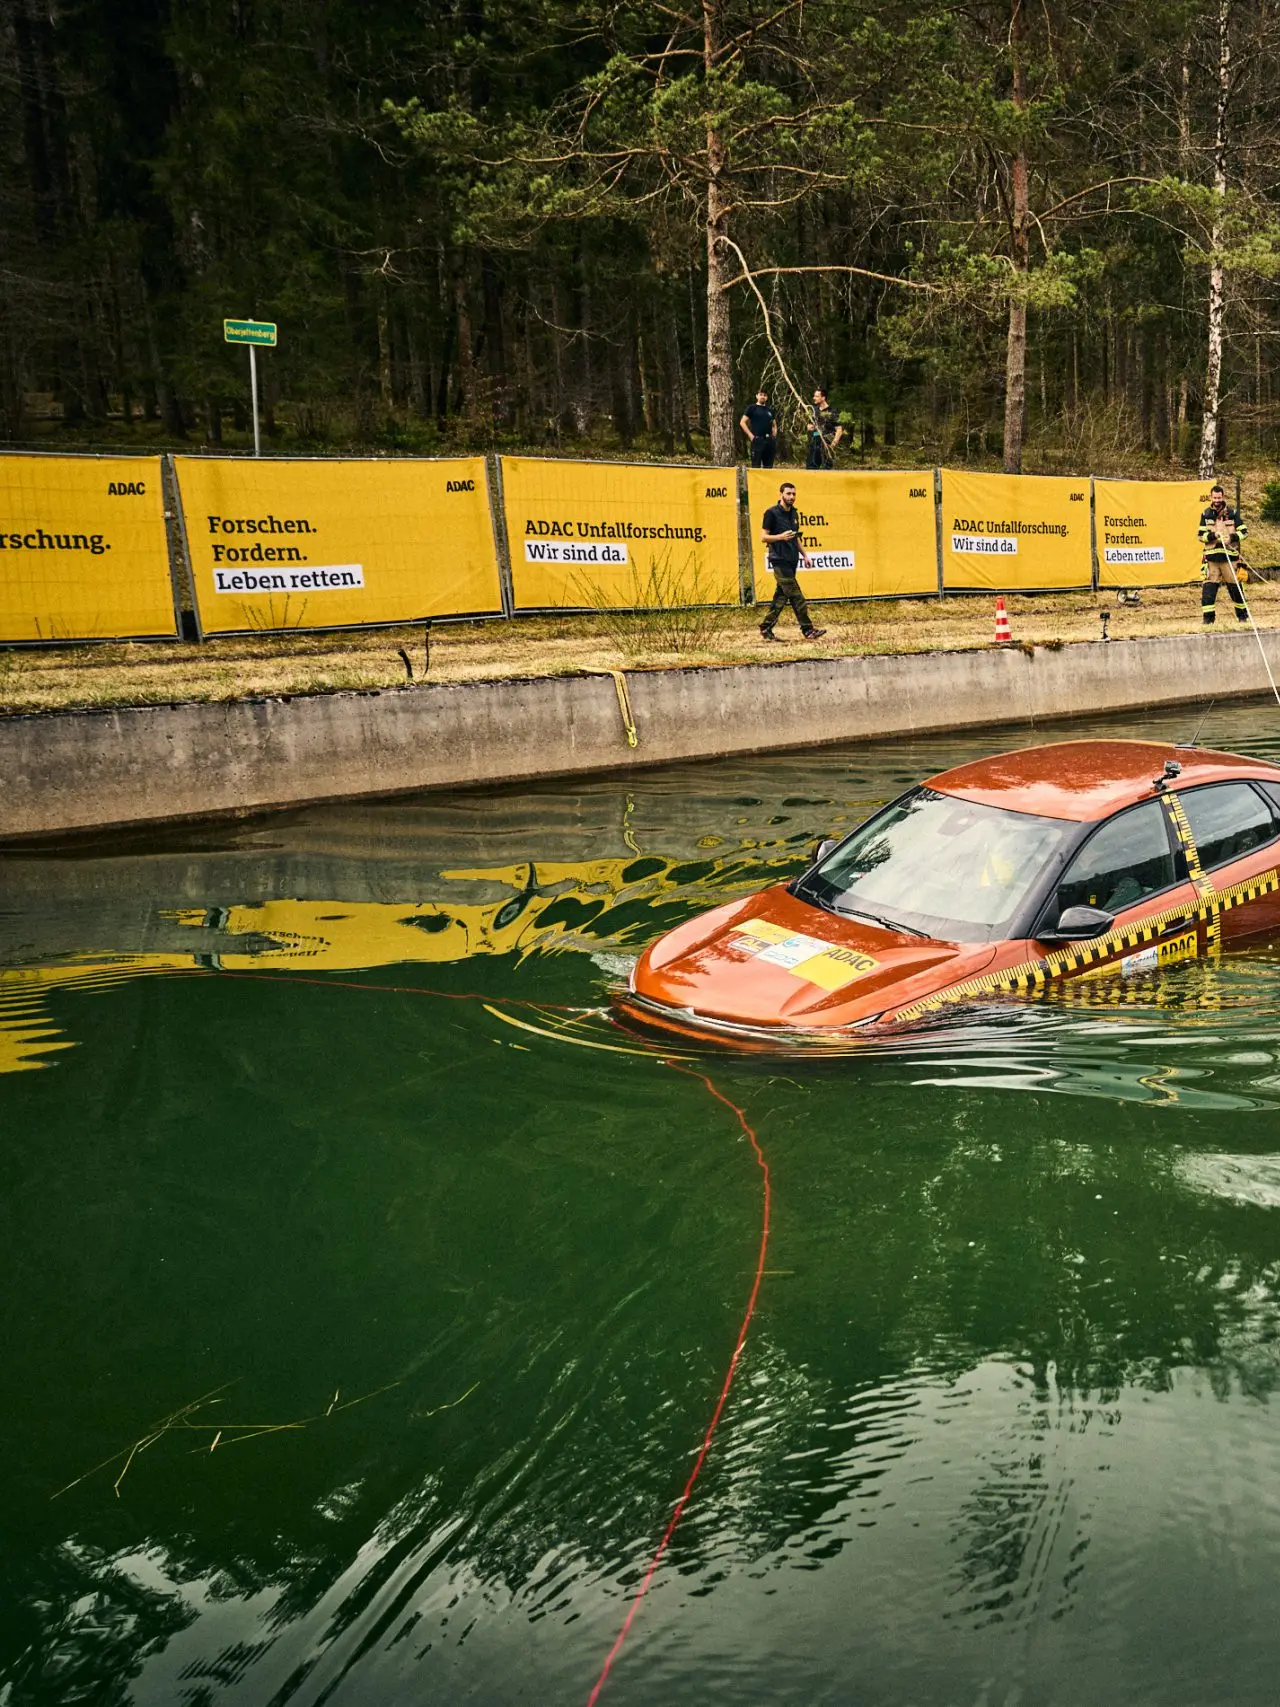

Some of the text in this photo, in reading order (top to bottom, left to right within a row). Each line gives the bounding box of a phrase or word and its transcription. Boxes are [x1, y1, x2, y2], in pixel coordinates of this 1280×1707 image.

[108, 481, 146, 496] ADAC
[446, 479, 475, 493] ADAC
[705, 487, 727, 498] ADAC
[909, 488, 927, 498] ADAC
[1069, 493, 1085, 502] ADAC
[208, 515, 317, 534] Forschen.
[953, 519, 1070, 538] ADAC Unfallforschung.
[1104, 516, 1147, 527] Forschen.
[525, 520, 707, 543] ADAC Unfallforschung.
[1105, 533, 1143, 544] Fordern.
[212, 542, 308, 562] Fordern.
[953, 537, 1016, 552] Wir sind da.
[527, 544, 626, 561] Wir sind da.
[1105, 550, 1164, 562] Leben retten.
[217, 570, 362, 590] Leben retten.
[1160, 935, 1195, 957] ADAC
[823, 948, 875, 972] ADAC
